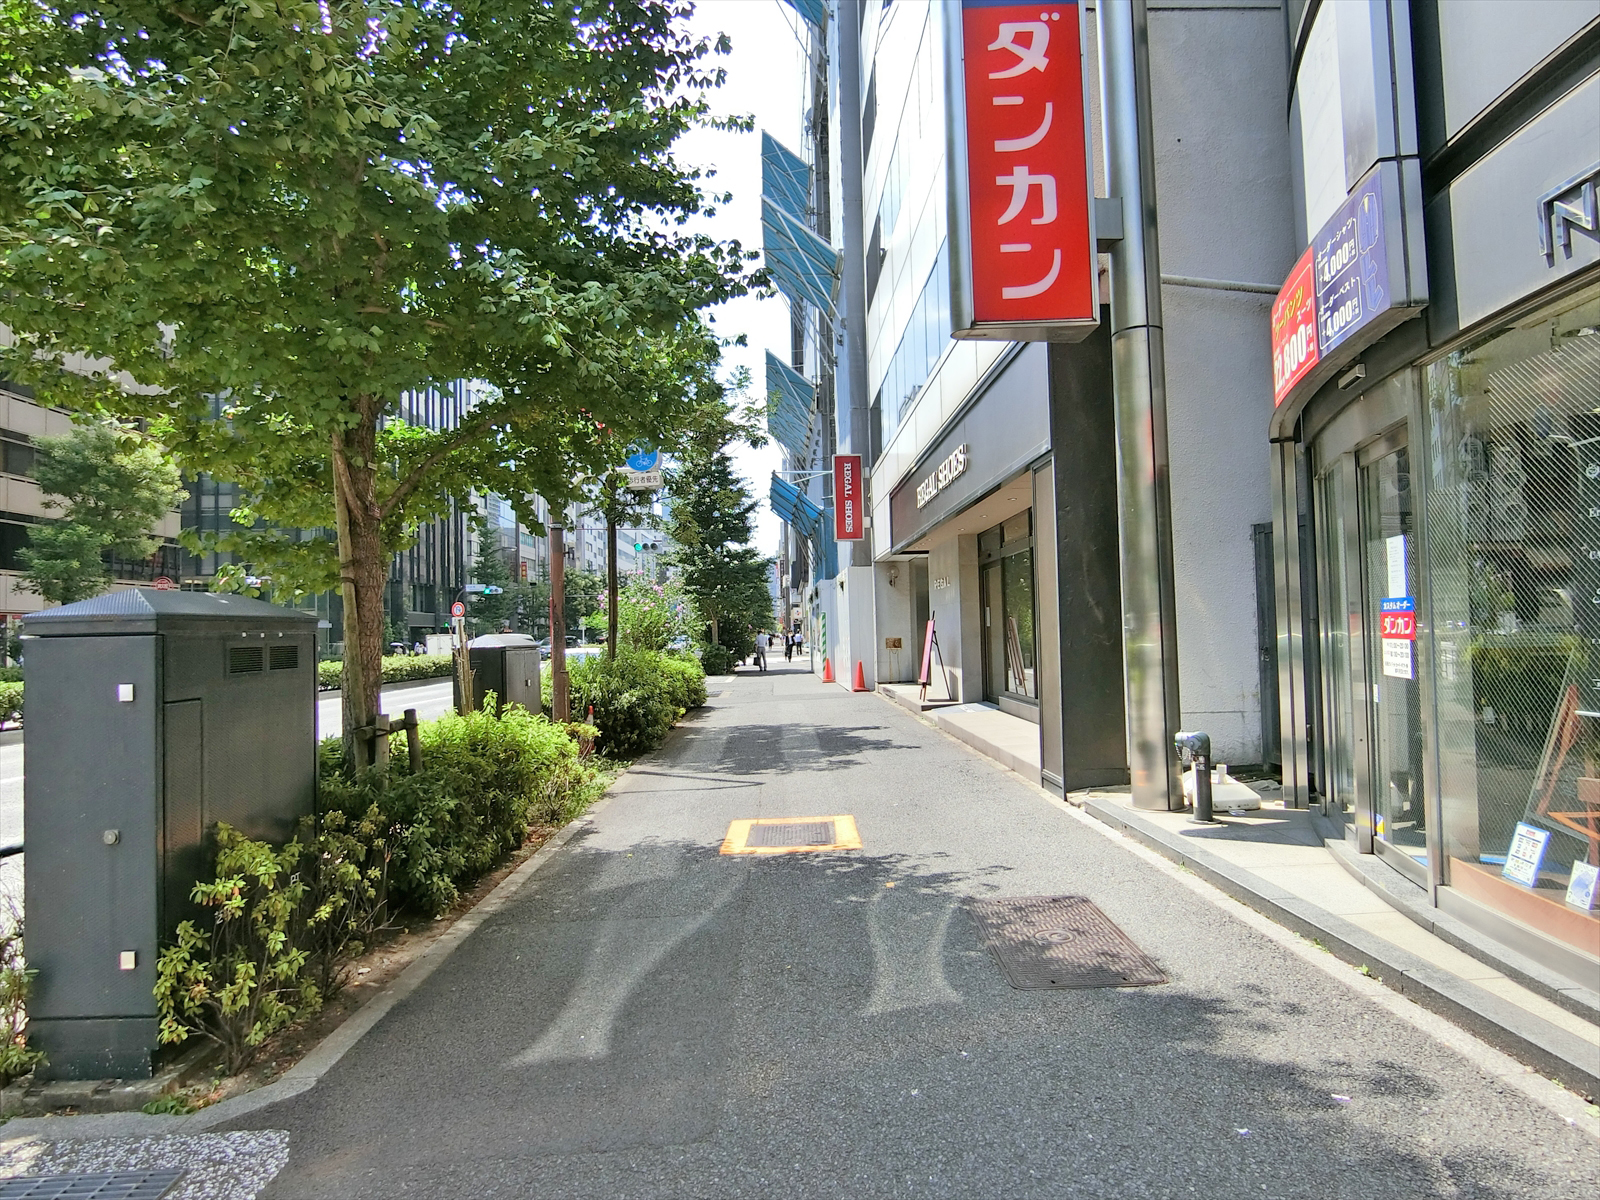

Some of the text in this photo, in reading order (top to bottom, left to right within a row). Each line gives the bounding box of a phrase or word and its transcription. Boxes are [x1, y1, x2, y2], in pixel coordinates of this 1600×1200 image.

[987, 12, 1061, 300] ダンカン
[1317, 217, 1353, 261] オーダーシャツ
[1319, 276, 1356, 314] オーダーベスト
[844, 462, 853, 533] REGAL SHOES
[917, 443, 967, 508] REGAL SHOES
[1383, 615, 1412, 635] ダンカン
